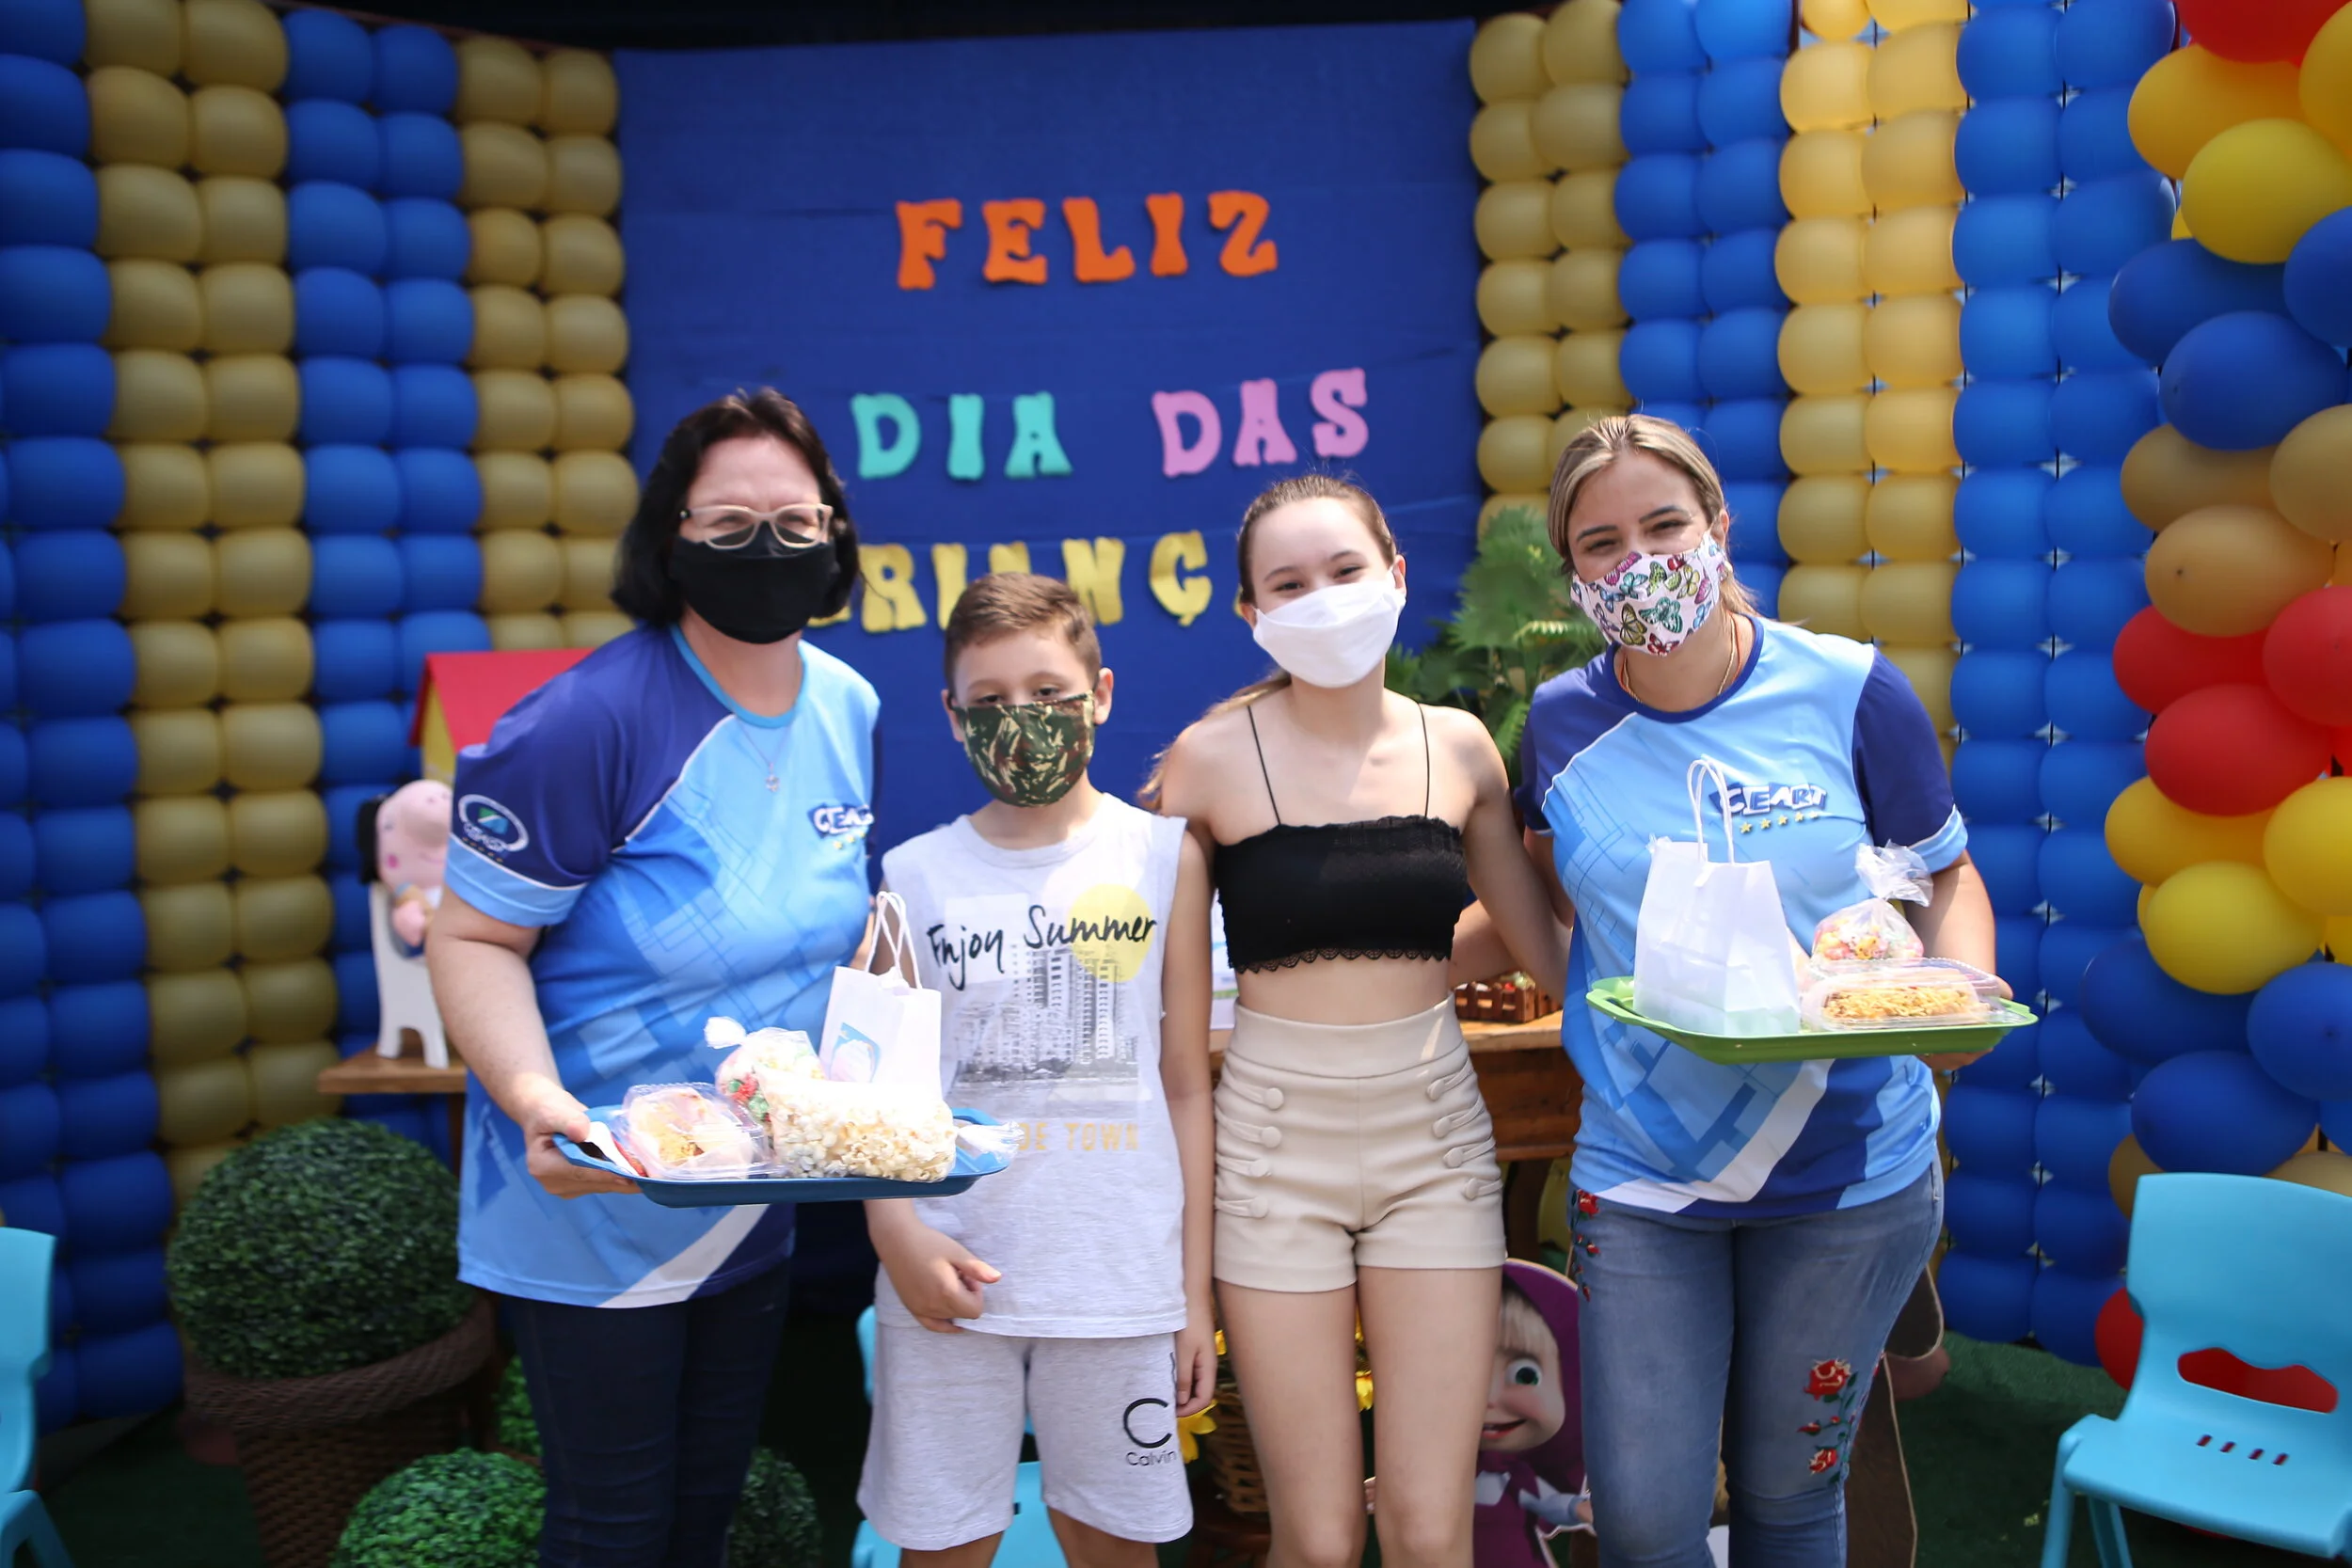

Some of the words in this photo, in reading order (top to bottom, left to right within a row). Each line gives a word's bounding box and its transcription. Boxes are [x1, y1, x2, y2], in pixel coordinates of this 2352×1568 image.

[896, 191, 1279, 291] FELIZ
[850, 391, 1073, 480] DIA
[1152, 368, 1369, 477] DAS
[927, 923, 1006, 991] Enjoy
[1023, 904, 1158, 950] Summer
[1063, 1121, 1140, 1152] TOWN
[1125, 1449, 1177, 1466] Calvin
